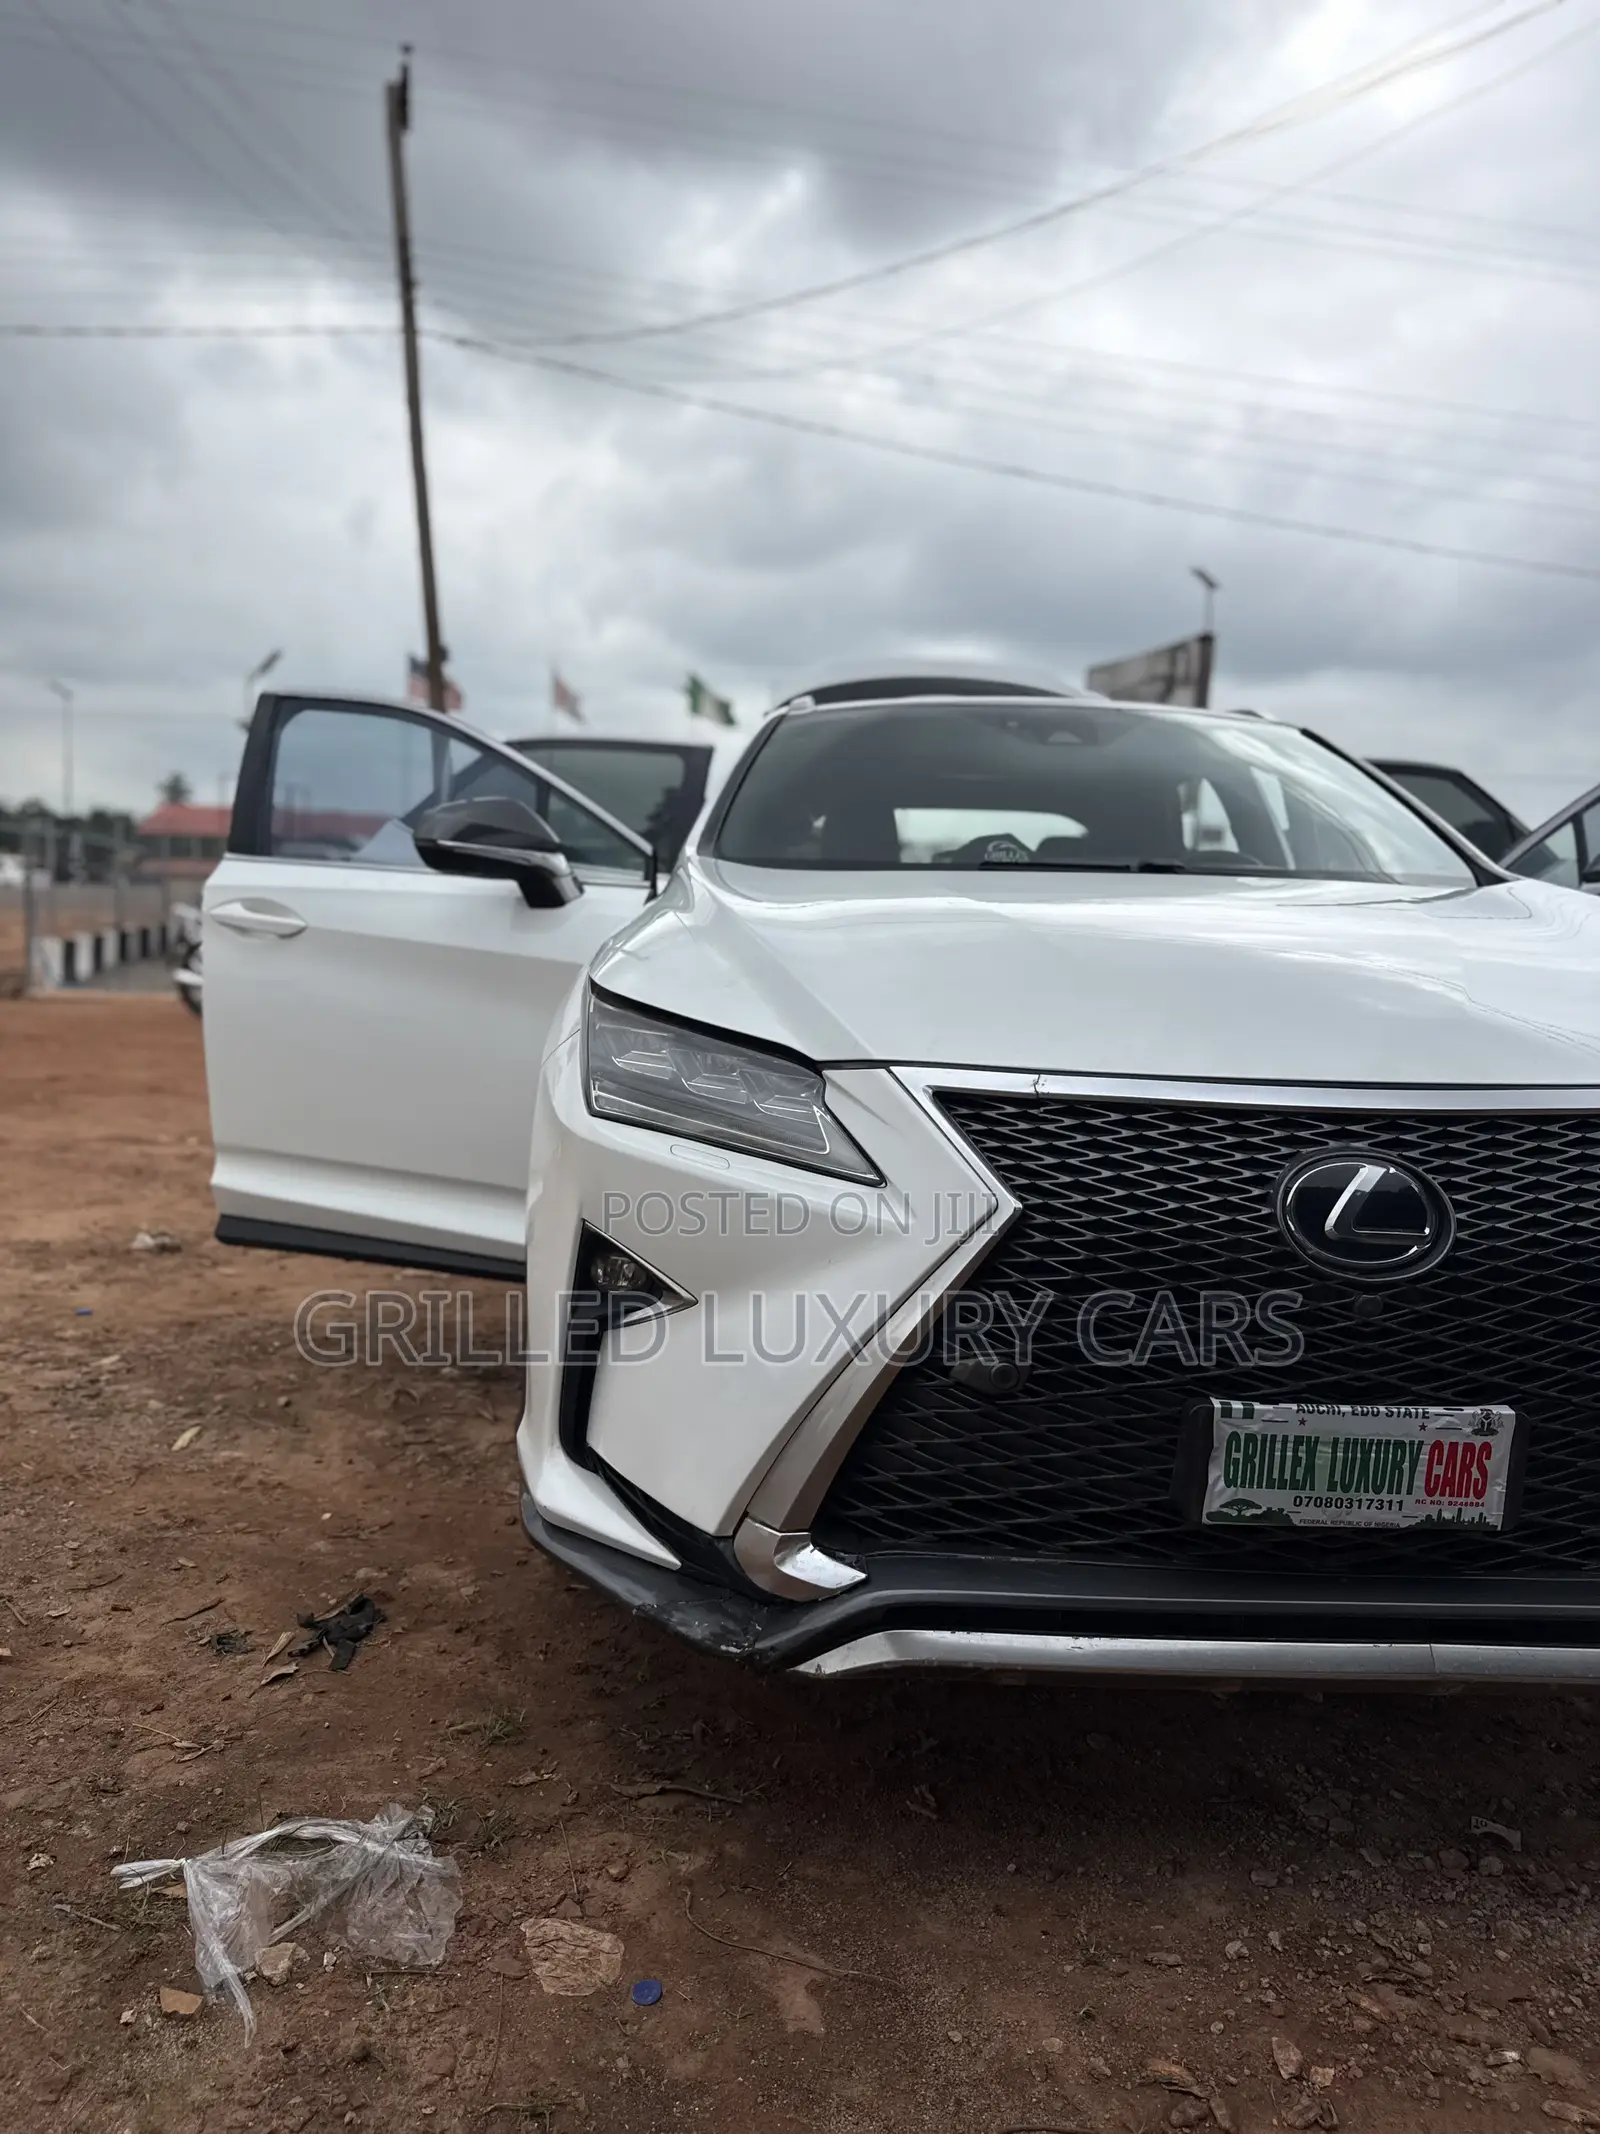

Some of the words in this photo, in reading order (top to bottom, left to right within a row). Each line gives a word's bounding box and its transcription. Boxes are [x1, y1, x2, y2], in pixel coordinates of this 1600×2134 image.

[1296, 1403, 1346, 1417] AUCHI,
[1350, 1405, 1380, 1417] EDO
[1385, 1406, 1430, 1419] STATE
[1223, 1430, 1320, 1491] GRILLEX
[1326, 1437, 1424, 1496] LUXURY
[1424, 1439, 1492, 1500] CARS
[1292, 1495, 1404, 1511] 07080317311
